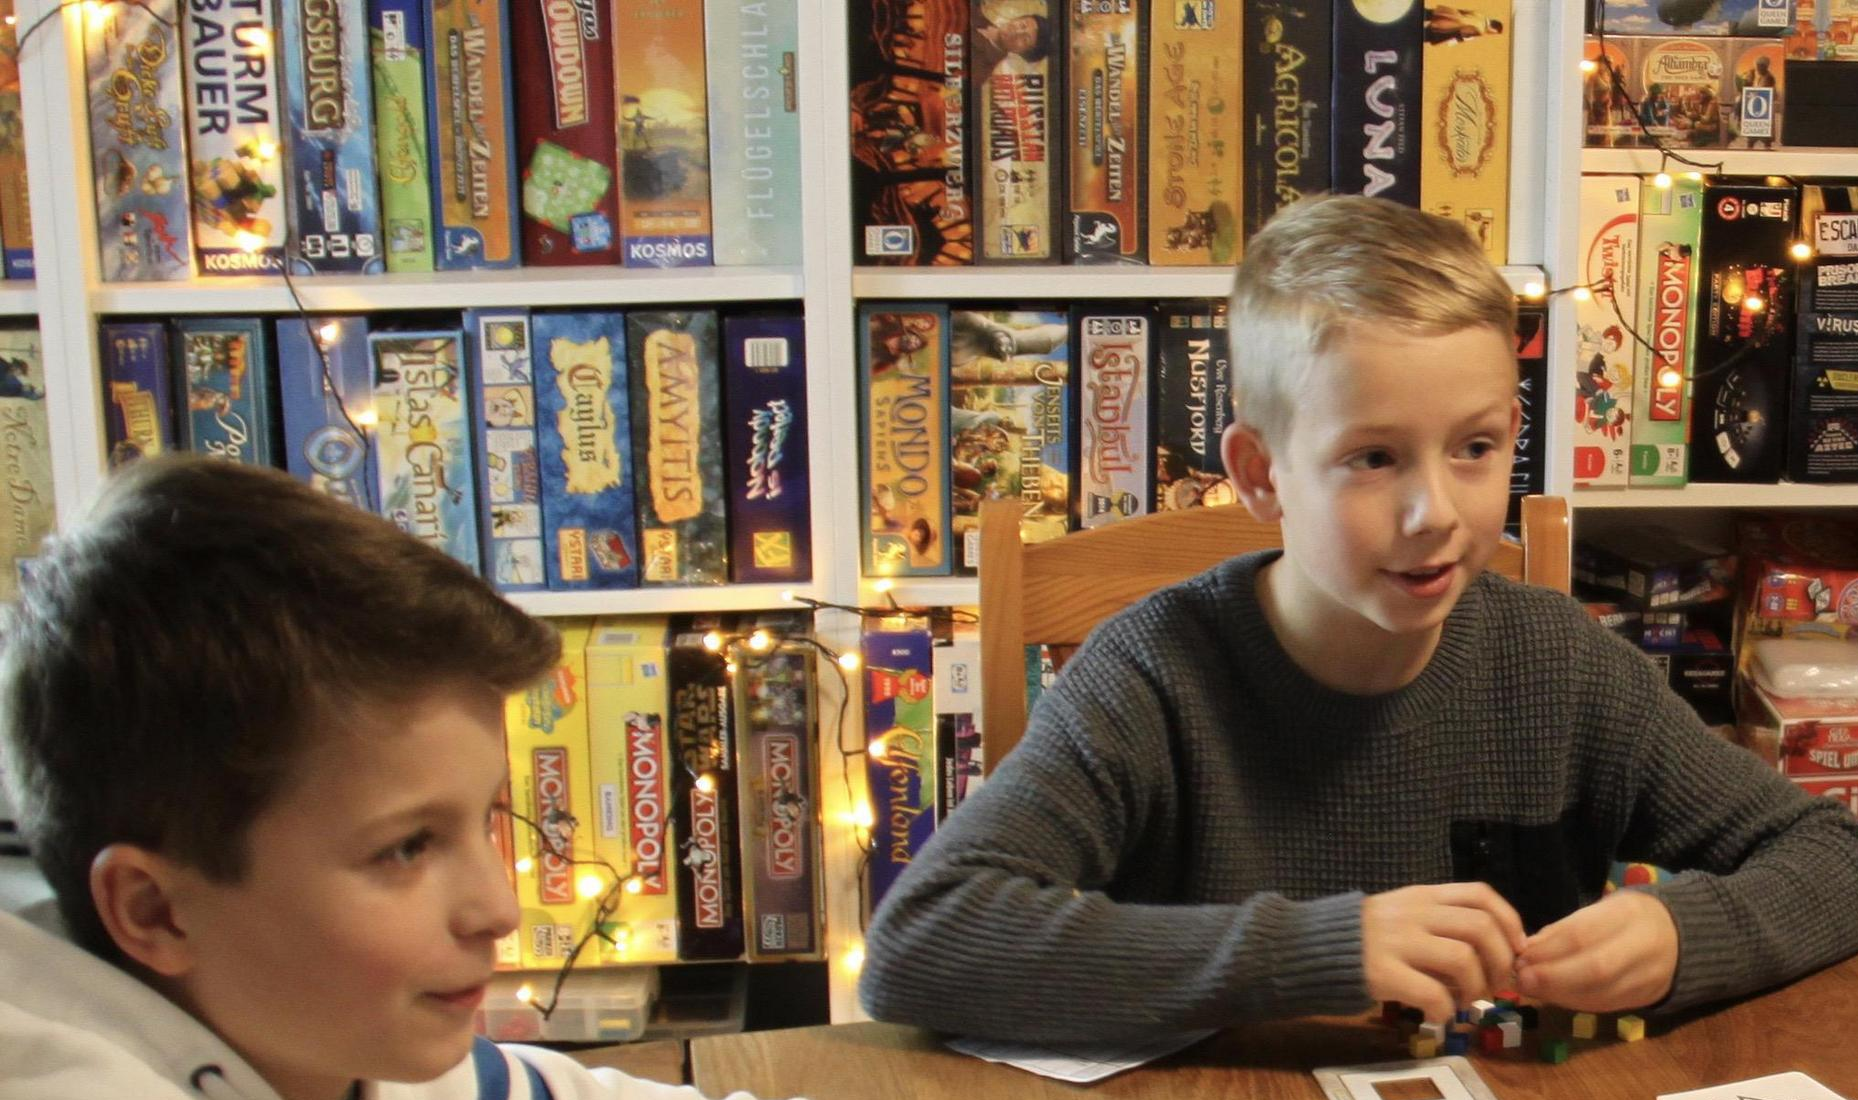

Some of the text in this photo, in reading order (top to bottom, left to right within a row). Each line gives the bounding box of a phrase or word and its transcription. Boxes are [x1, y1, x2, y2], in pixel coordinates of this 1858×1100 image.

[463, 27, 487, 123] WANDEL
[1106, 42, 1127, 201] WANDEL ZEITEN
[1163, 41, 1187, 109] AGE
[1275, 43, 1307, 208] AGRICOLA
[1362, 50, 1398, 197] LUNA
[467, 138, 491, 218] ZEITEN
[630, 242, 708, 260] KOSMOS
[567, 362, 603, 463] Caylus
[656, 341, 695, 502] AMYITIS
[891, 373, 932, 497] MONDO
[1089, 342, 1141, 478] Istanbul
[405, 441, 449, 542] Canari
[1020, 430, 1046, 519] THEBEN
[632, 733, 662, 889] MONOPOLY
[1809, 748, 1841, 768] SPIEL
[695, 792, 719, 925] MONOPOLY
